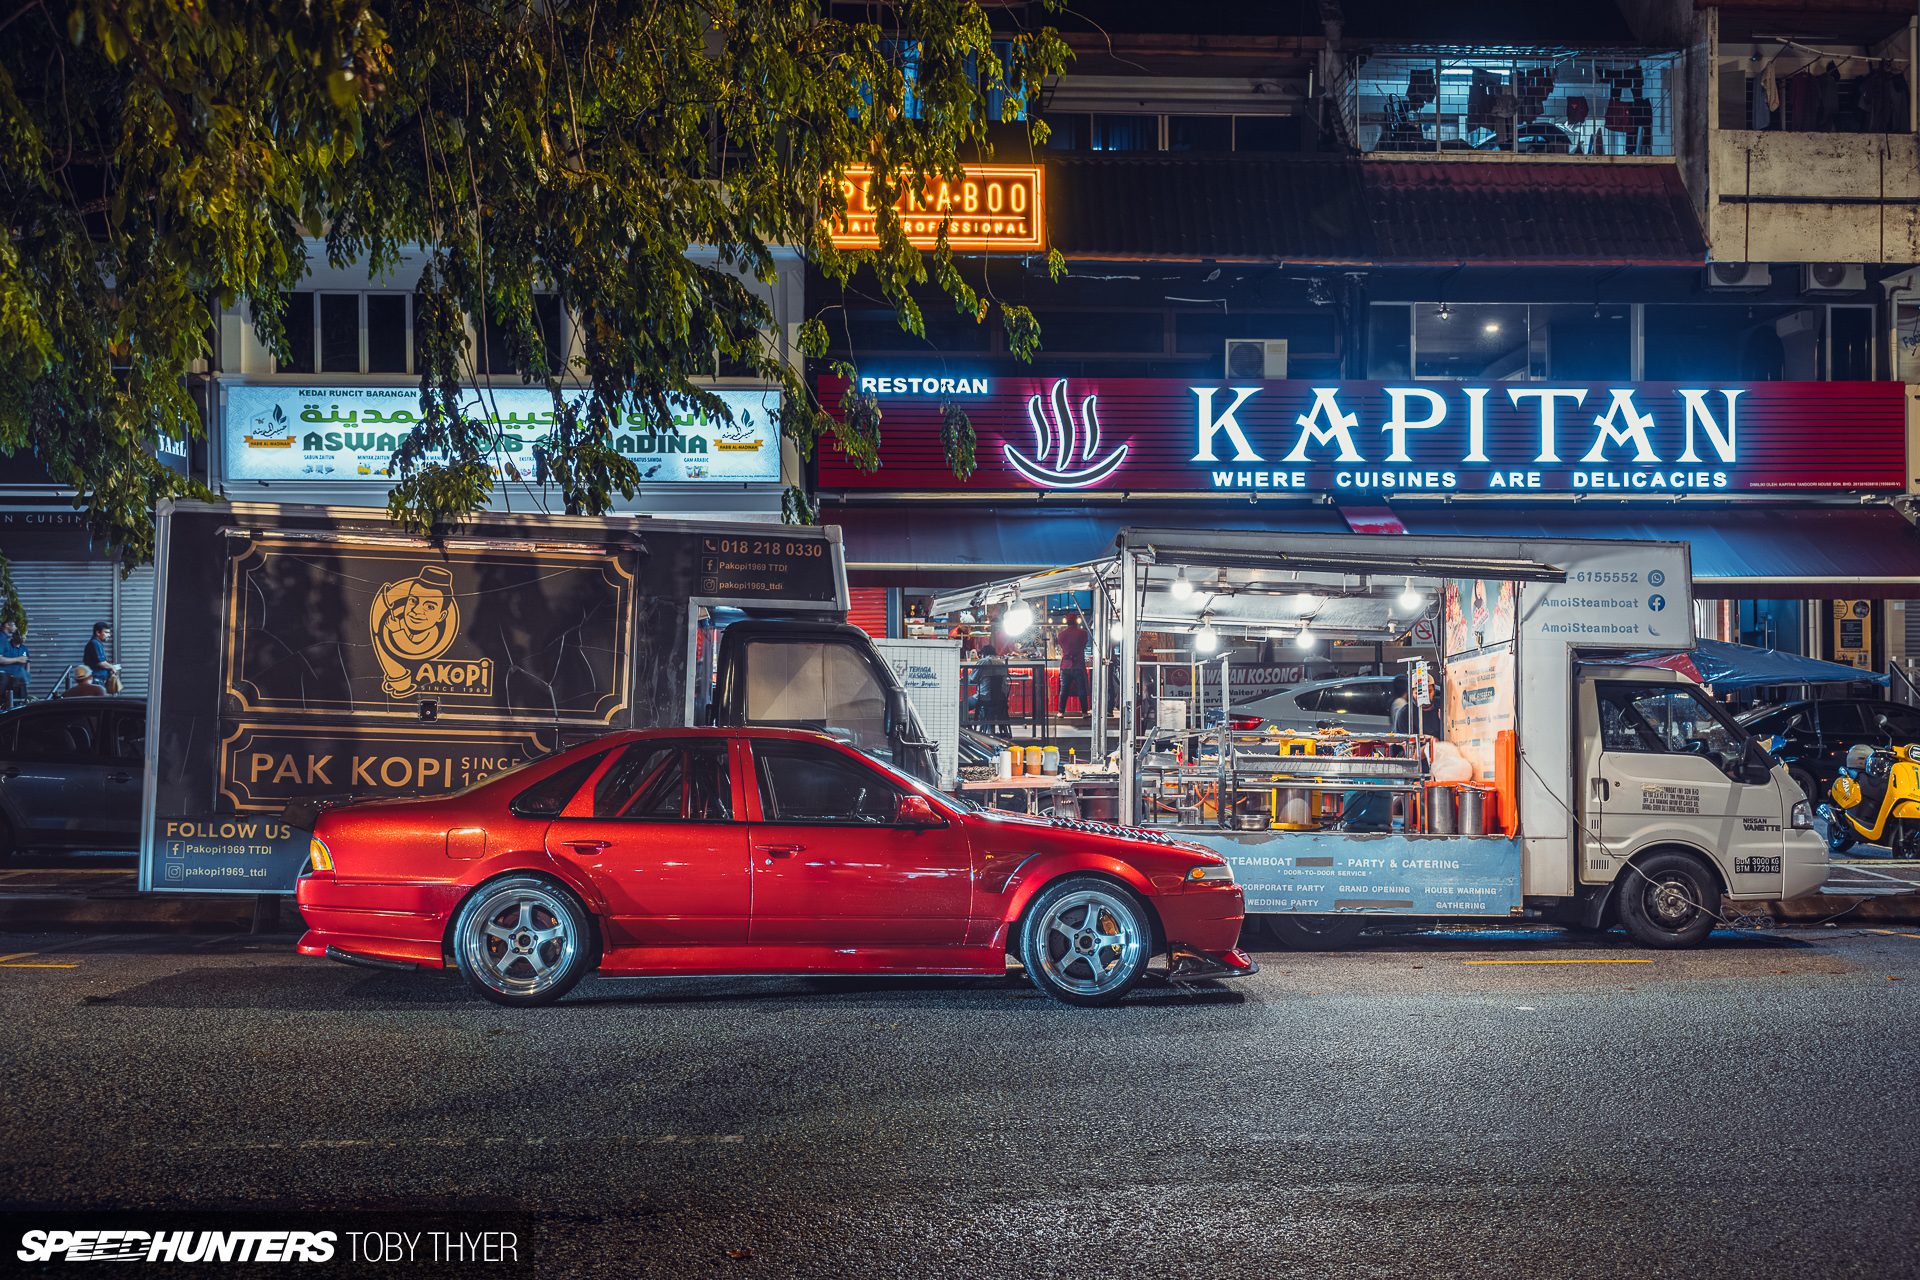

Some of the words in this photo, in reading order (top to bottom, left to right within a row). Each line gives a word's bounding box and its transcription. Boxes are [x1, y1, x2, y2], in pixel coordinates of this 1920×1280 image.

[903, 222, 1027, 234] ROFSSIONAL
[862, 377, 988, 394] RESTORAN
[1190, 387, 1746, 463] KAPITAN
[1212, 471, 1306, 487] WHERE
[1336, 472, 1456, 487] CUISINES
[1489, 472, 1541, 487] ARE
[1573, 472, 1728, 488] DELICACIES
[721, 540, 748, 554] 018
[753, 541, 781, 555] 218
[785, 543, 822, 557] 0330
[719, 562, 766, 571] Pakopi1969
[768, 563, 788, 572] TTDI
[719, 581, 783, 591] pakopi1969_ttdi
[1541, 597, 1638, 608] AmoiSteamboat
[1541, 622, 1639, 633] AmoiSteamboat
[1247, 667, 1298, 684] KOSONG
[250, 753, 333, 785] PAK
[351, 755, 452, 788] KOPI
[461, 757, 521, 770] SINCE
[167, 822, 257, 838] FOLLOW
[265, 824, 291, 839] US
[186, 845, 245, 855] Pakopi1969
[248, 845, 272, 855] TTDI
[1348, 859, 1385, 868] PARTY
[1390, 859, 1397, 868] &
[1402, 860, 1459, 869] CATERING
[1752, 857, 1770, 865] 3000
[1771, 857, 1779, 865] KG
[185, 866, 267, 877] pakopi1969_ttdi
[1297, 884, 1325, 892] PARTY
[1339, 885, 1368, 893] GRAND
[1457, 887, 1497, 895] WARMING
